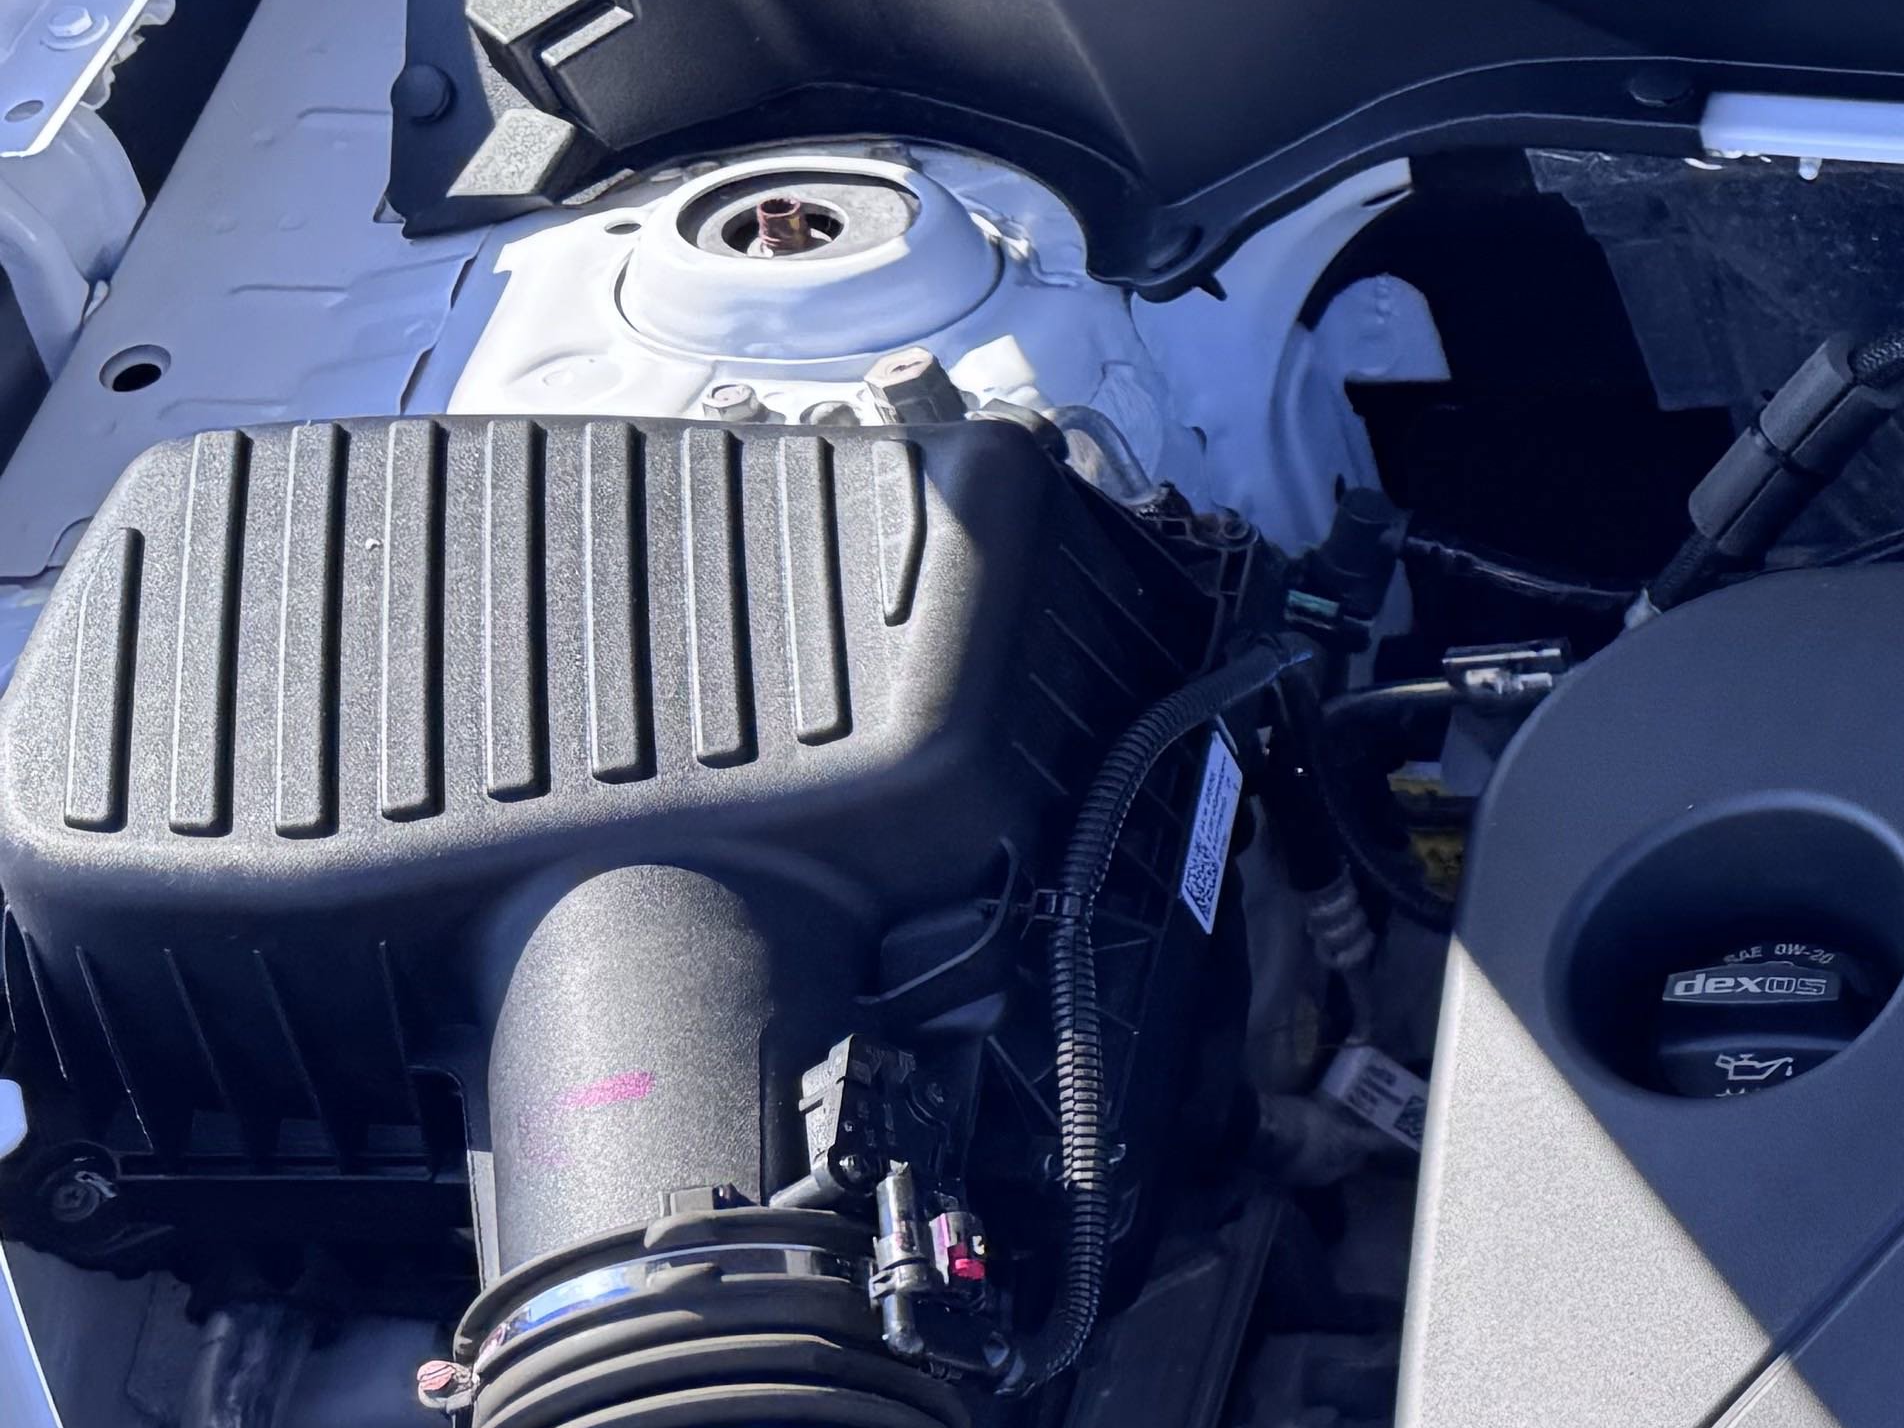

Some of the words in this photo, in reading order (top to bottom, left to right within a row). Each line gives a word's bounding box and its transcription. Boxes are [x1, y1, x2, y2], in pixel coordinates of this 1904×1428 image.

[1723, 946, 1763, 963] SAE
[1774, 943, 1836, 964] 0W-20
[1674, 973, 1827, 996] dexos
